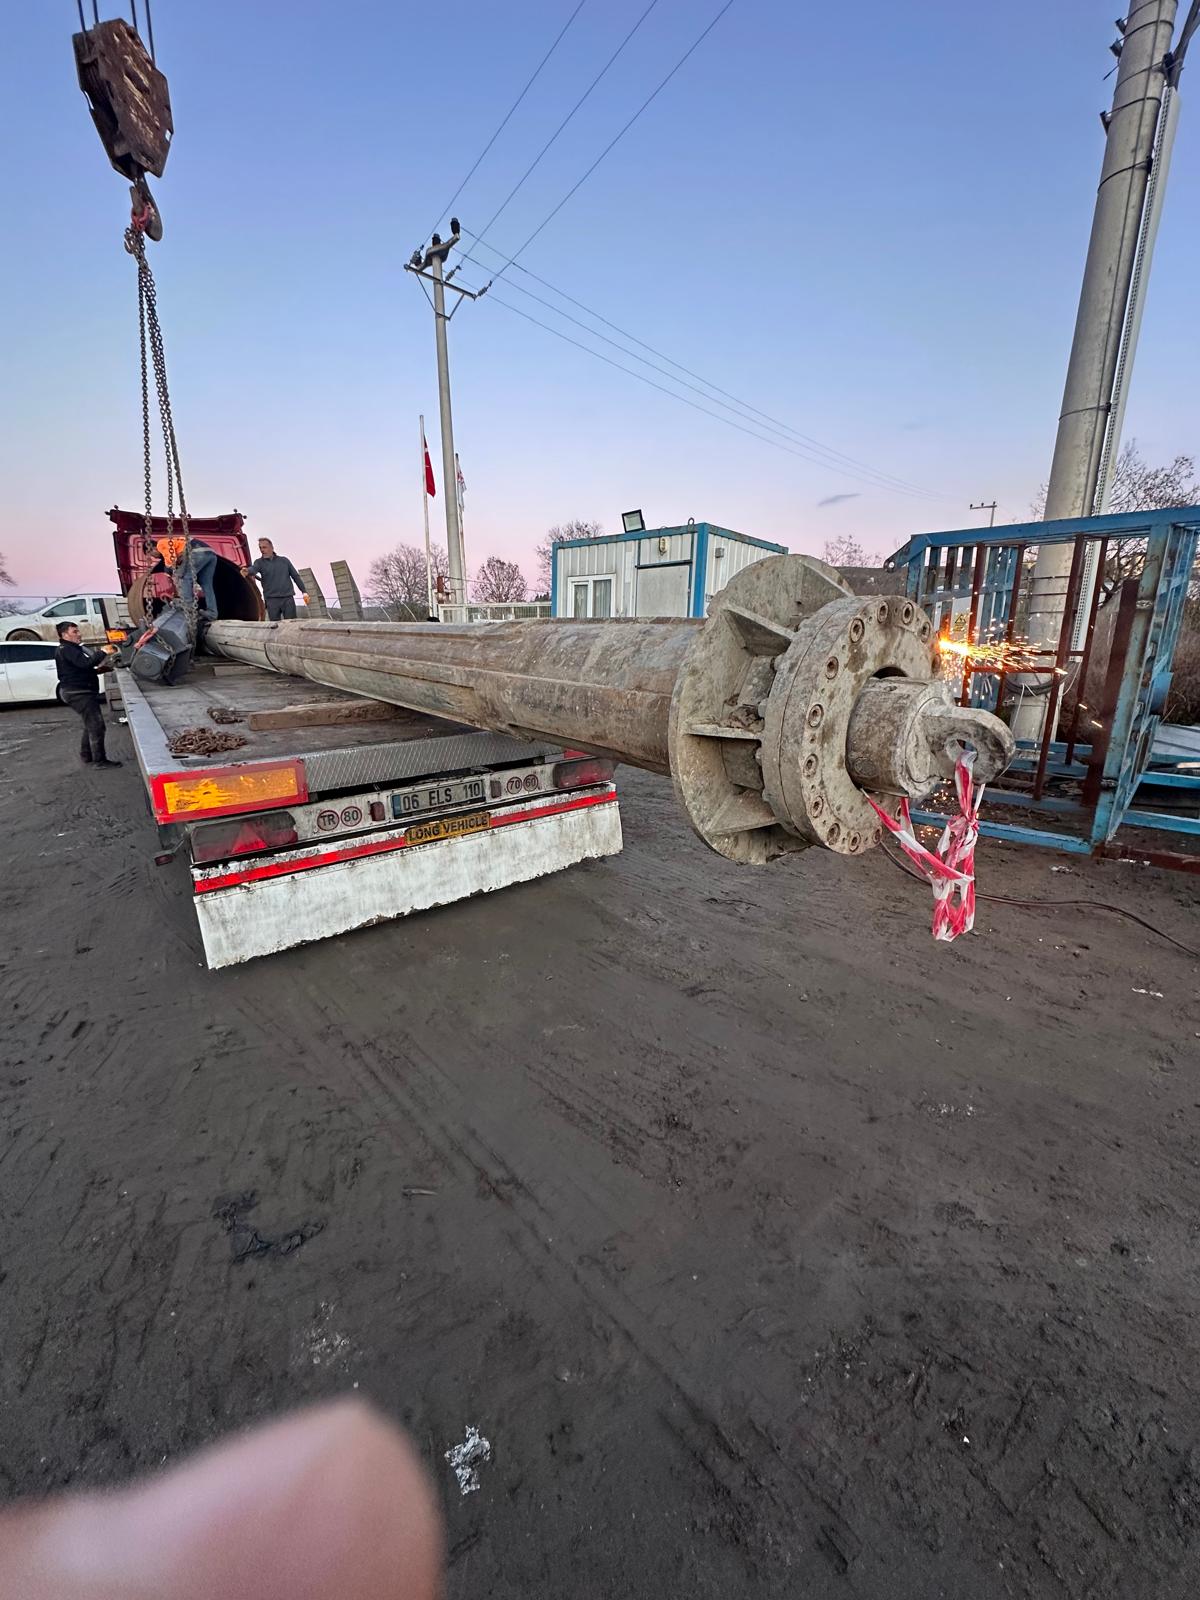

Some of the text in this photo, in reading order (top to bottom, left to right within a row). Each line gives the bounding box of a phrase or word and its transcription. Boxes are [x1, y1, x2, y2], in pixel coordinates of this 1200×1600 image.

[509, 779, 521, 791] 70
[525, 777, 536, 788] 60
[403, 782, 480, 811] 06 ELS 110
[320, 814, 336, 826] TR
[343, 810, 359, 822] 80
[408, 815, 488, 842] LONG VEHICLE
